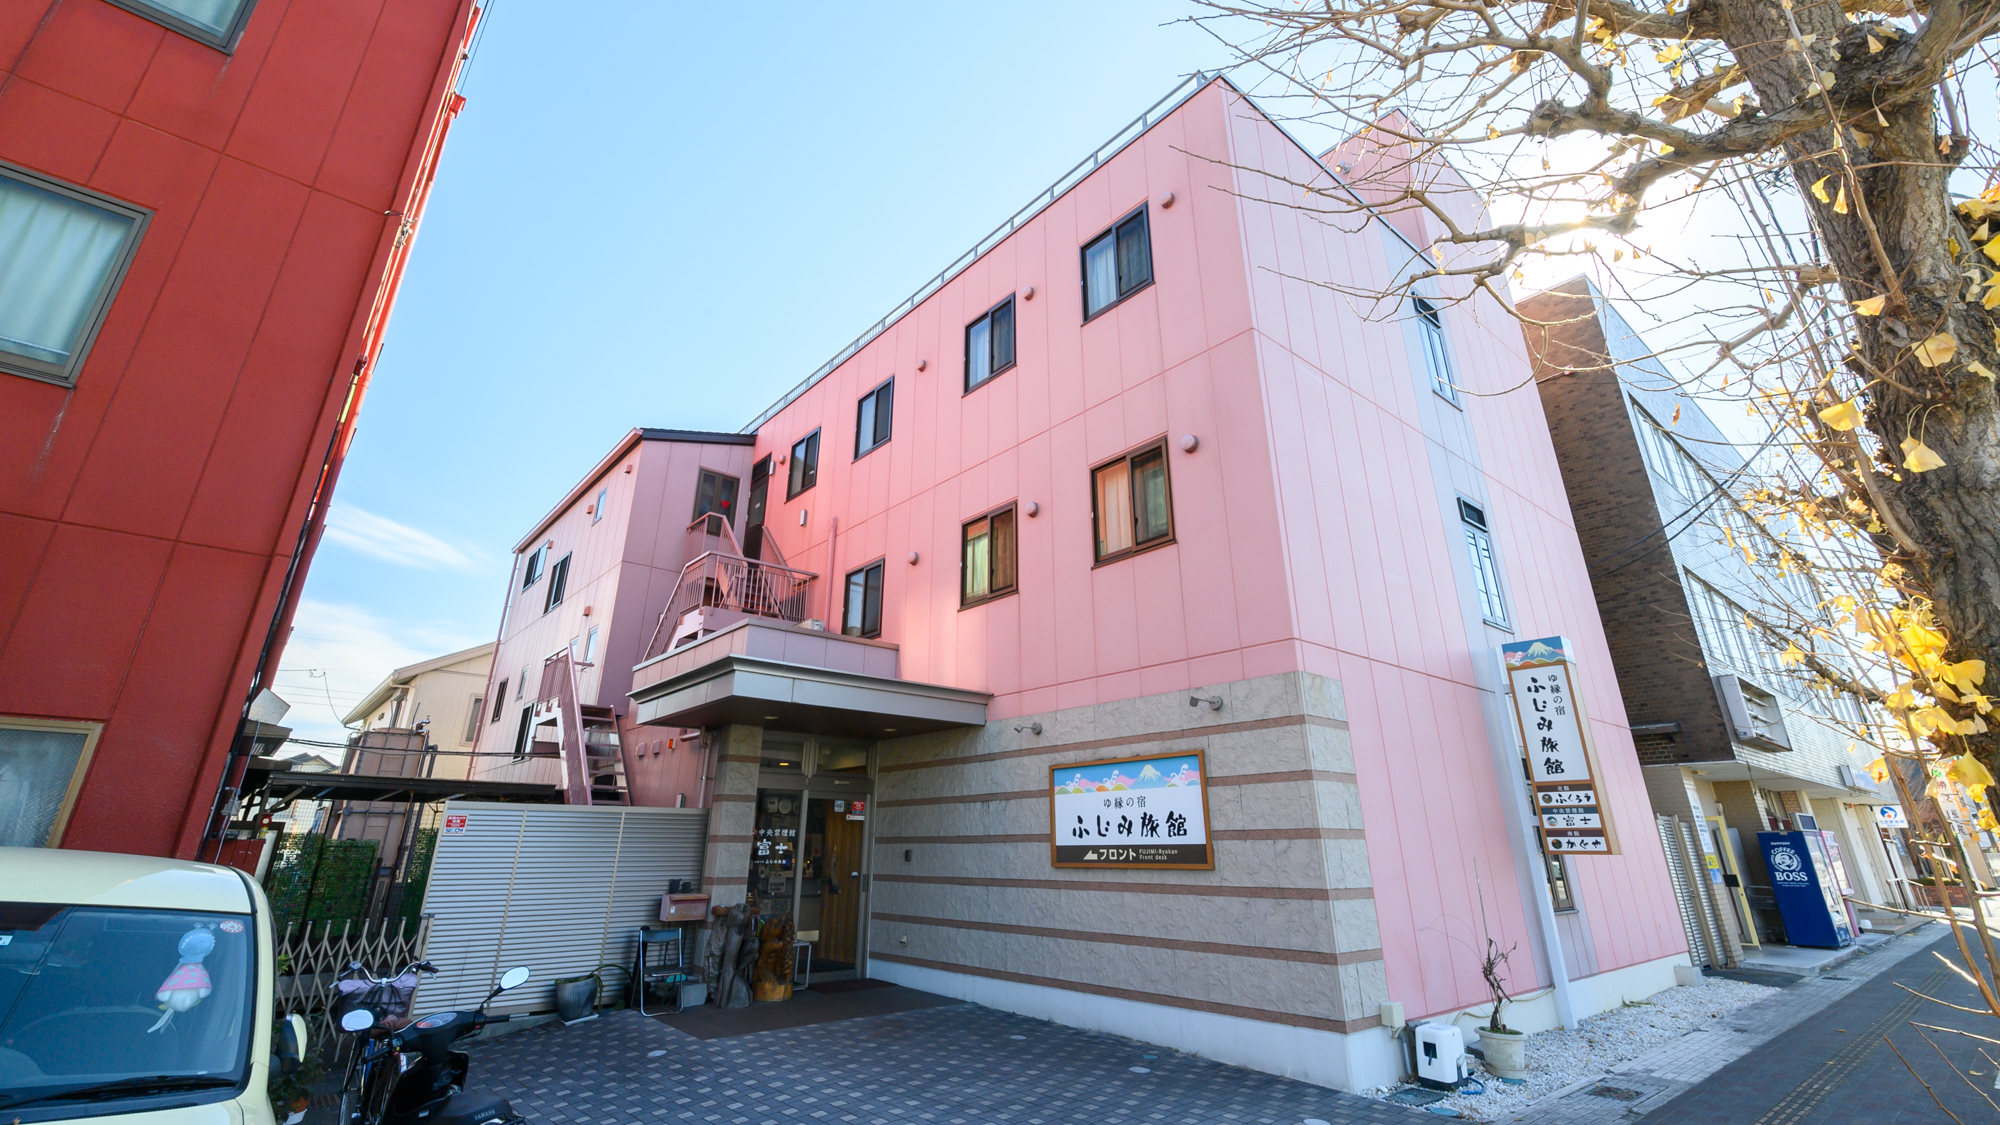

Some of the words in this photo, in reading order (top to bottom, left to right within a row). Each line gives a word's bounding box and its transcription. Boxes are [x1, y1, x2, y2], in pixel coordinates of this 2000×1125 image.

[1548, 674, 1566, 716] ゆ縁の宿
[1527, 676, 1565, 775] ふじみ旅館
[1103, 795, 1146, 809] ゆ縁の宿
[1555, 793, 1592, 804] ふくろう
[1072, 810, 1188, 839] ふじみ旅館
[1563, 815, 1592, 827] 富士
[758, 828, 797, 837] 中央禁煙館
[756, 838, 788, 856] 富士
[1566, 839, 1602, 849] かぐや
[1771, 846, 1796, 855] COFFEE
[1099, 848, 1137, 861] フロント
[1774, 871, 1808, 882] BOSS
[474, 1108, 496, 1121] YAMAHA
